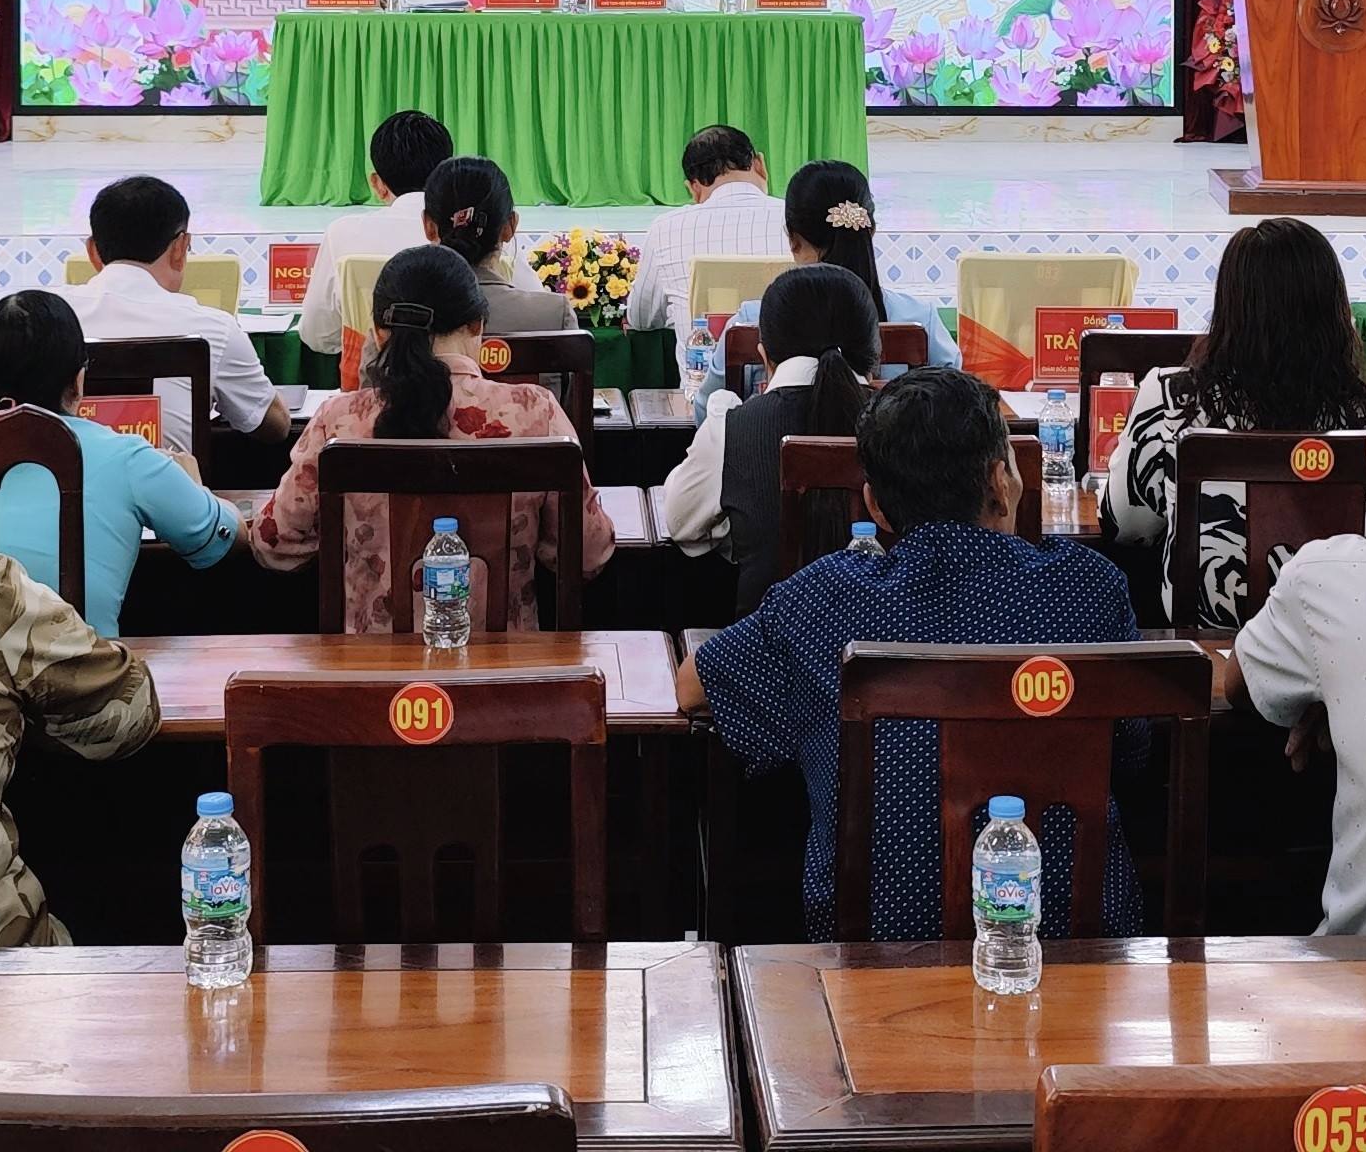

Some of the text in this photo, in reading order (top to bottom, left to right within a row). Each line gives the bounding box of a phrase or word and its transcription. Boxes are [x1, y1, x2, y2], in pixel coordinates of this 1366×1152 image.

[1044, 329, 1079, 350] TRẦ
[480, 347, 509, 365] 050
[79, 404, 96, 416] CHÍ
[1294, 449, 1329, 471] 089
[1018, 670, 1066, 701] 005
[396, 697, 444, 730] 091
[211, 880, 240, 895] laVie
